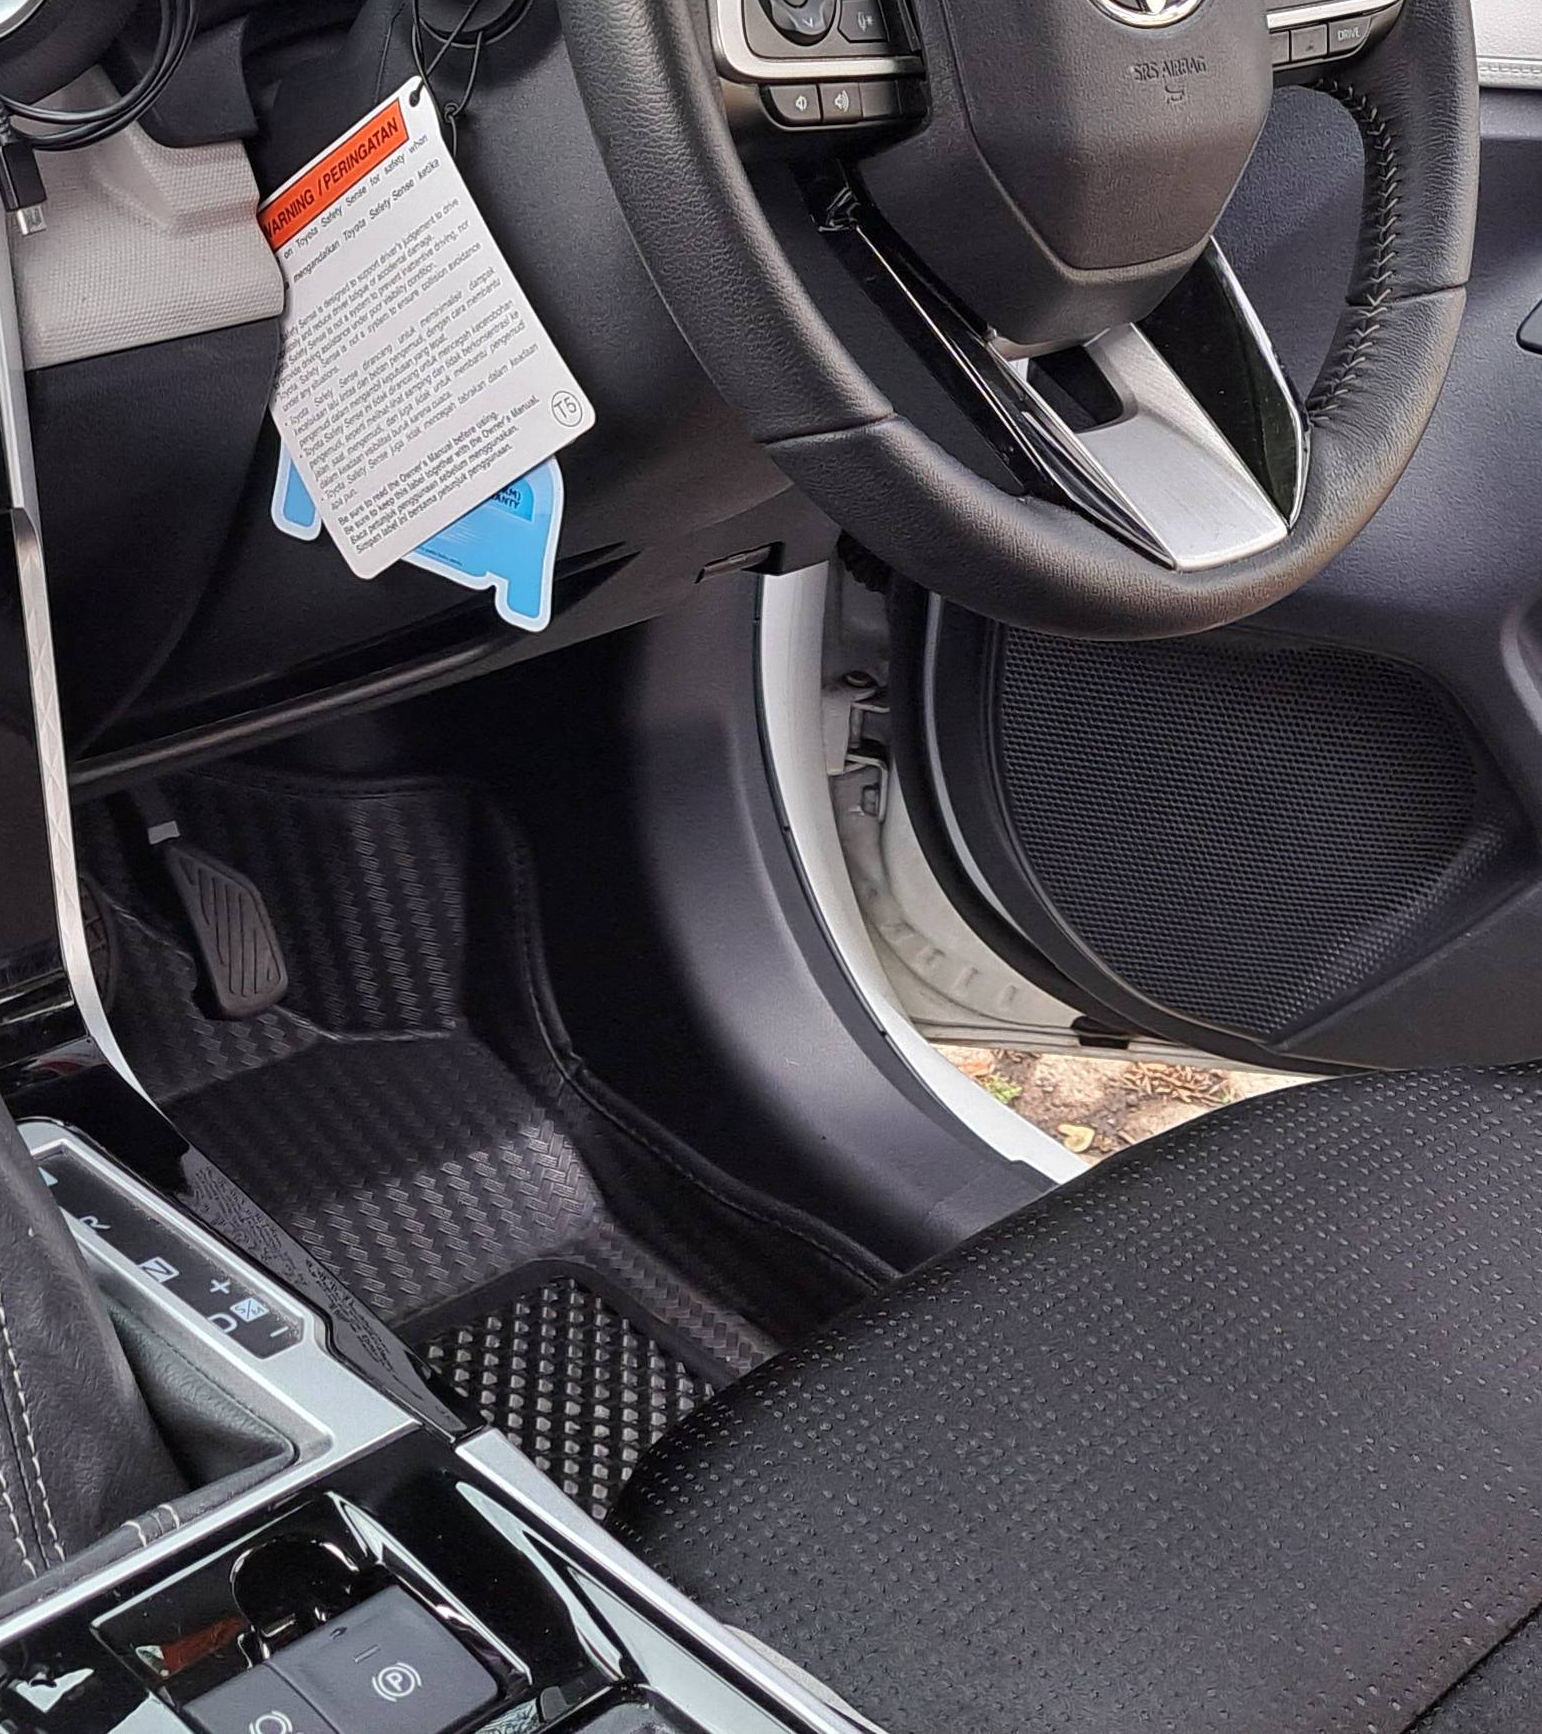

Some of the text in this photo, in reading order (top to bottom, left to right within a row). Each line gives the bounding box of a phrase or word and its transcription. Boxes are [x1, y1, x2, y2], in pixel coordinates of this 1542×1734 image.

[1337, 27, 1361, 42] DRIVE
[553, 396, 577, 418] T5
[207, 1312, 239, 1335] D
[385, 1671, 404, 1693] P
